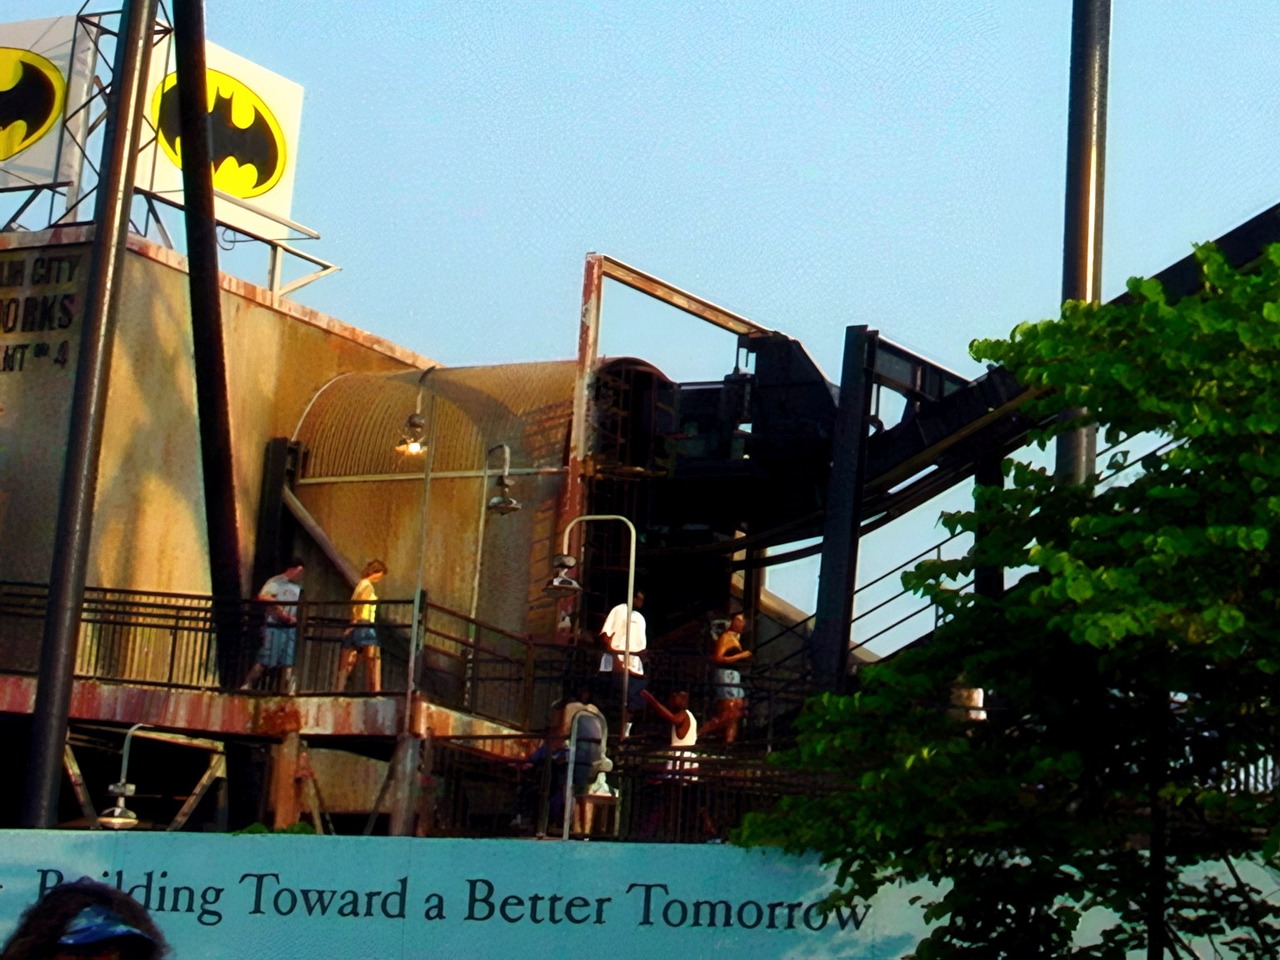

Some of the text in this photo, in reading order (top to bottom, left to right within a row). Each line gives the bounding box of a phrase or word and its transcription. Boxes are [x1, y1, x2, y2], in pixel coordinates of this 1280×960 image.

[31, 255, 82, 285] CITY
[0, 294, 75, 333] ORKS
[239, 873, 407, 919] Toward
[424, 893, 446, 921] a
[464, 879, 612, 925] Better
[626, 883, 872, 931] Tomorrow
